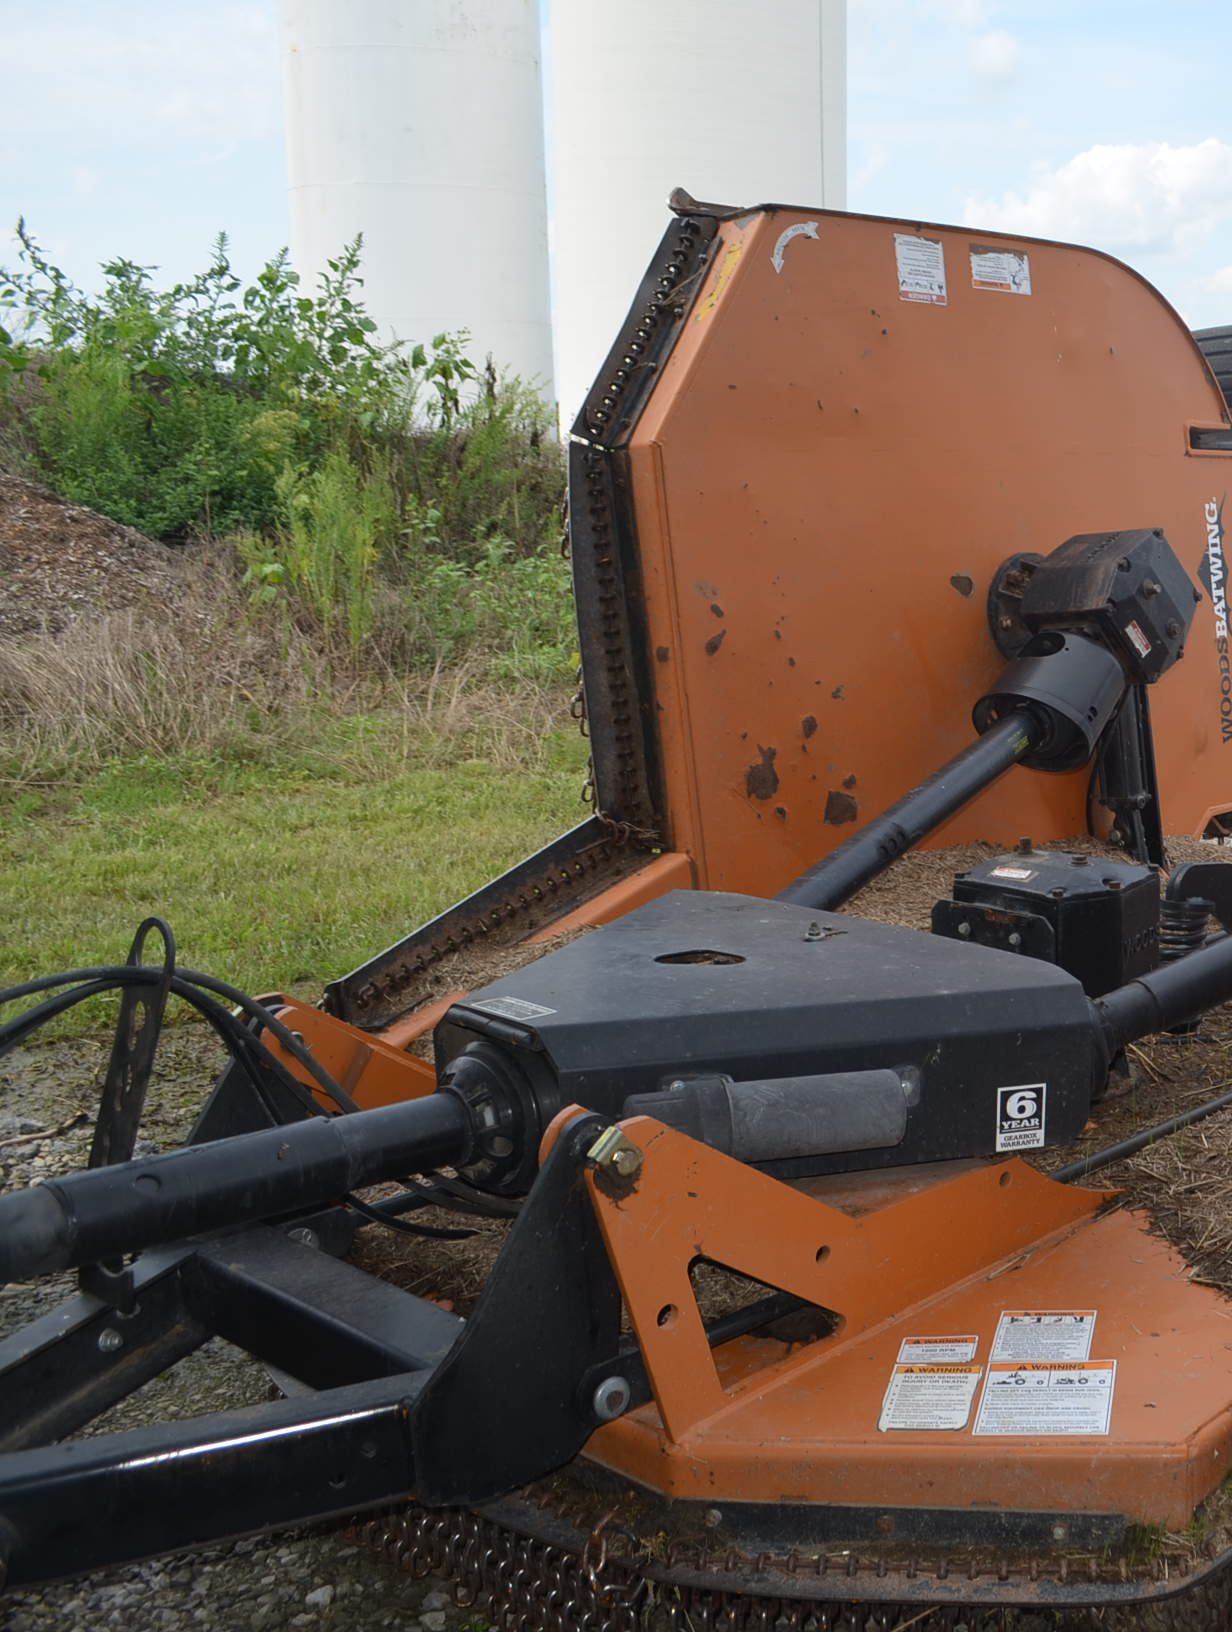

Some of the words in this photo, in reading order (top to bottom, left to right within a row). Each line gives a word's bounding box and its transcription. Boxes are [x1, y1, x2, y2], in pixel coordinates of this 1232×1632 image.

[1006, 1090, 1038, 1119] 6
[1001, 1118, 1040, 1130] YEAR
[1003, 1132, 1038, 1142] GEARBOX
[1000, 1138, 1041, 1149] WARRANTY
[918, 1366, 974, 1374] WARNING
[1031, 1363, 1086, 1371] WARNING
